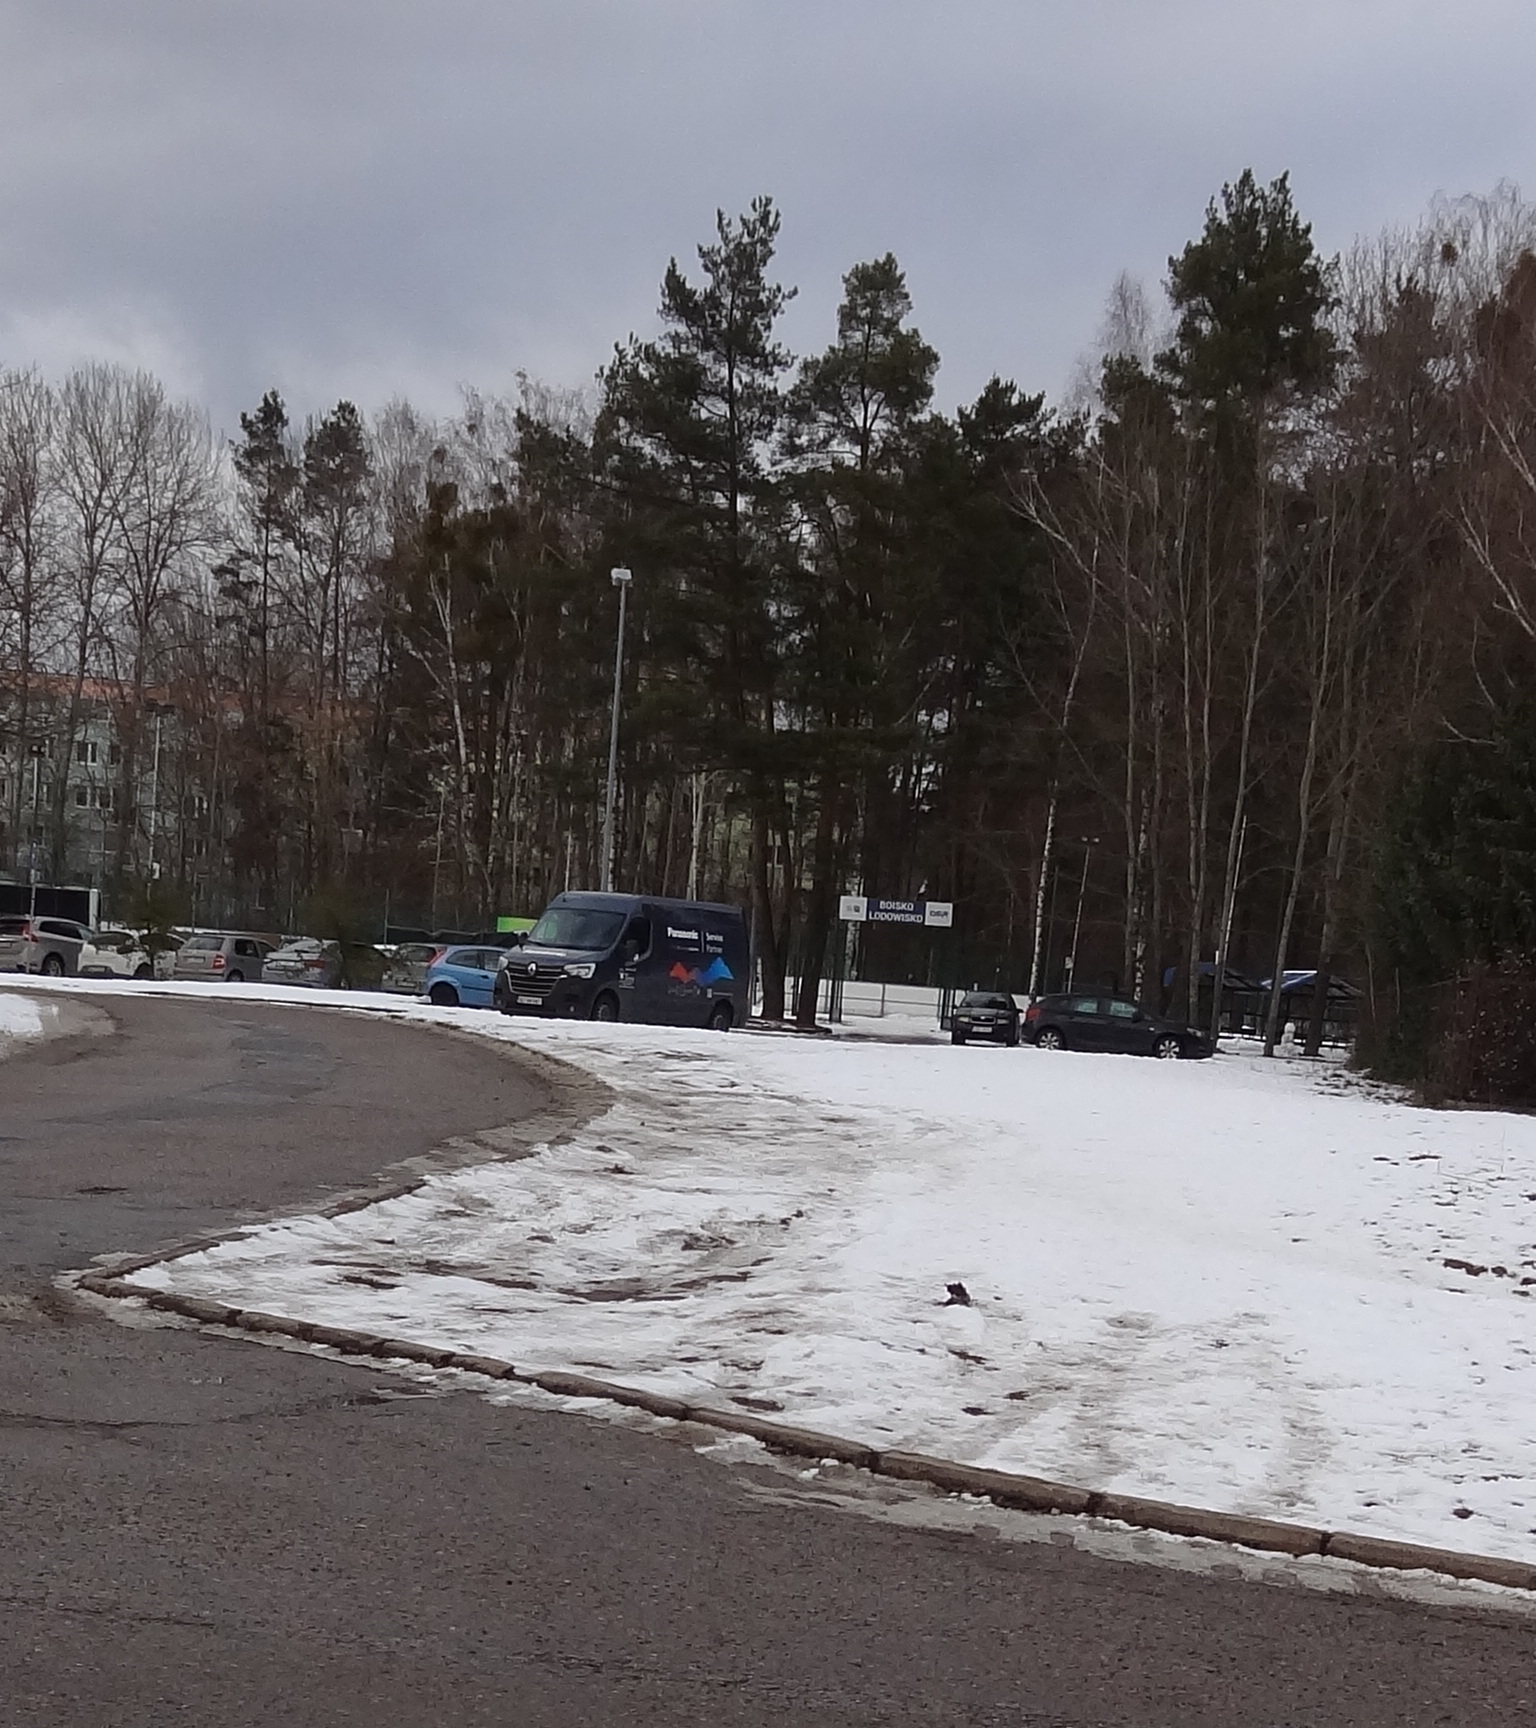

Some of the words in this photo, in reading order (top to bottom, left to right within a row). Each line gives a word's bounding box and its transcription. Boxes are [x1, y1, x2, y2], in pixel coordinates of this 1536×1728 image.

[879, 900, 915, 911] BOISKO
[868, 910, 924, 923] LODOWISKO
[667, 926, 699, 940] Panasonic
